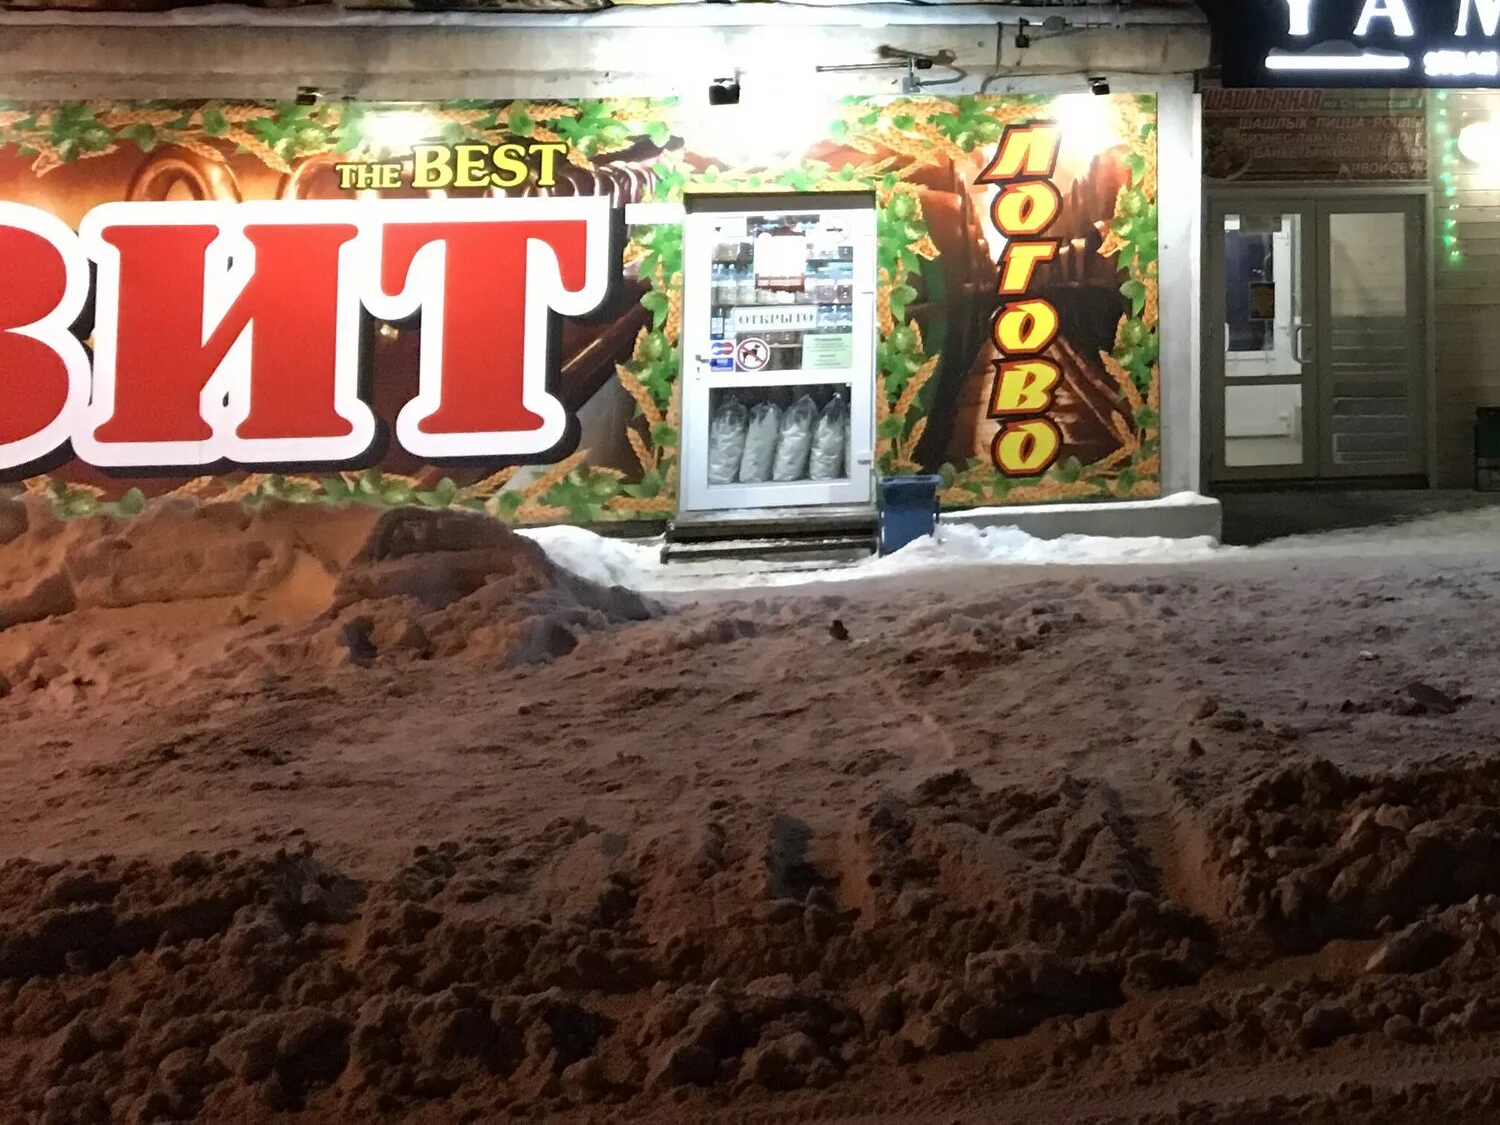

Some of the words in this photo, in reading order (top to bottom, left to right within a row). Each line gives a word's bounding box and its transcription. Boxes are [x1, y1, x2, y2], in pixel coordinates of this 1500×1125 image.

[1204, 88, 1323, 112] ШАШЛЫЧНАЯ
[336, 162, 402, 189] THE
[411, 143, 570, 190] BEST
[974, 119, 1064, 479] ЛОГОВО
[738, 313, 814, 325] ОТКРЫТО
